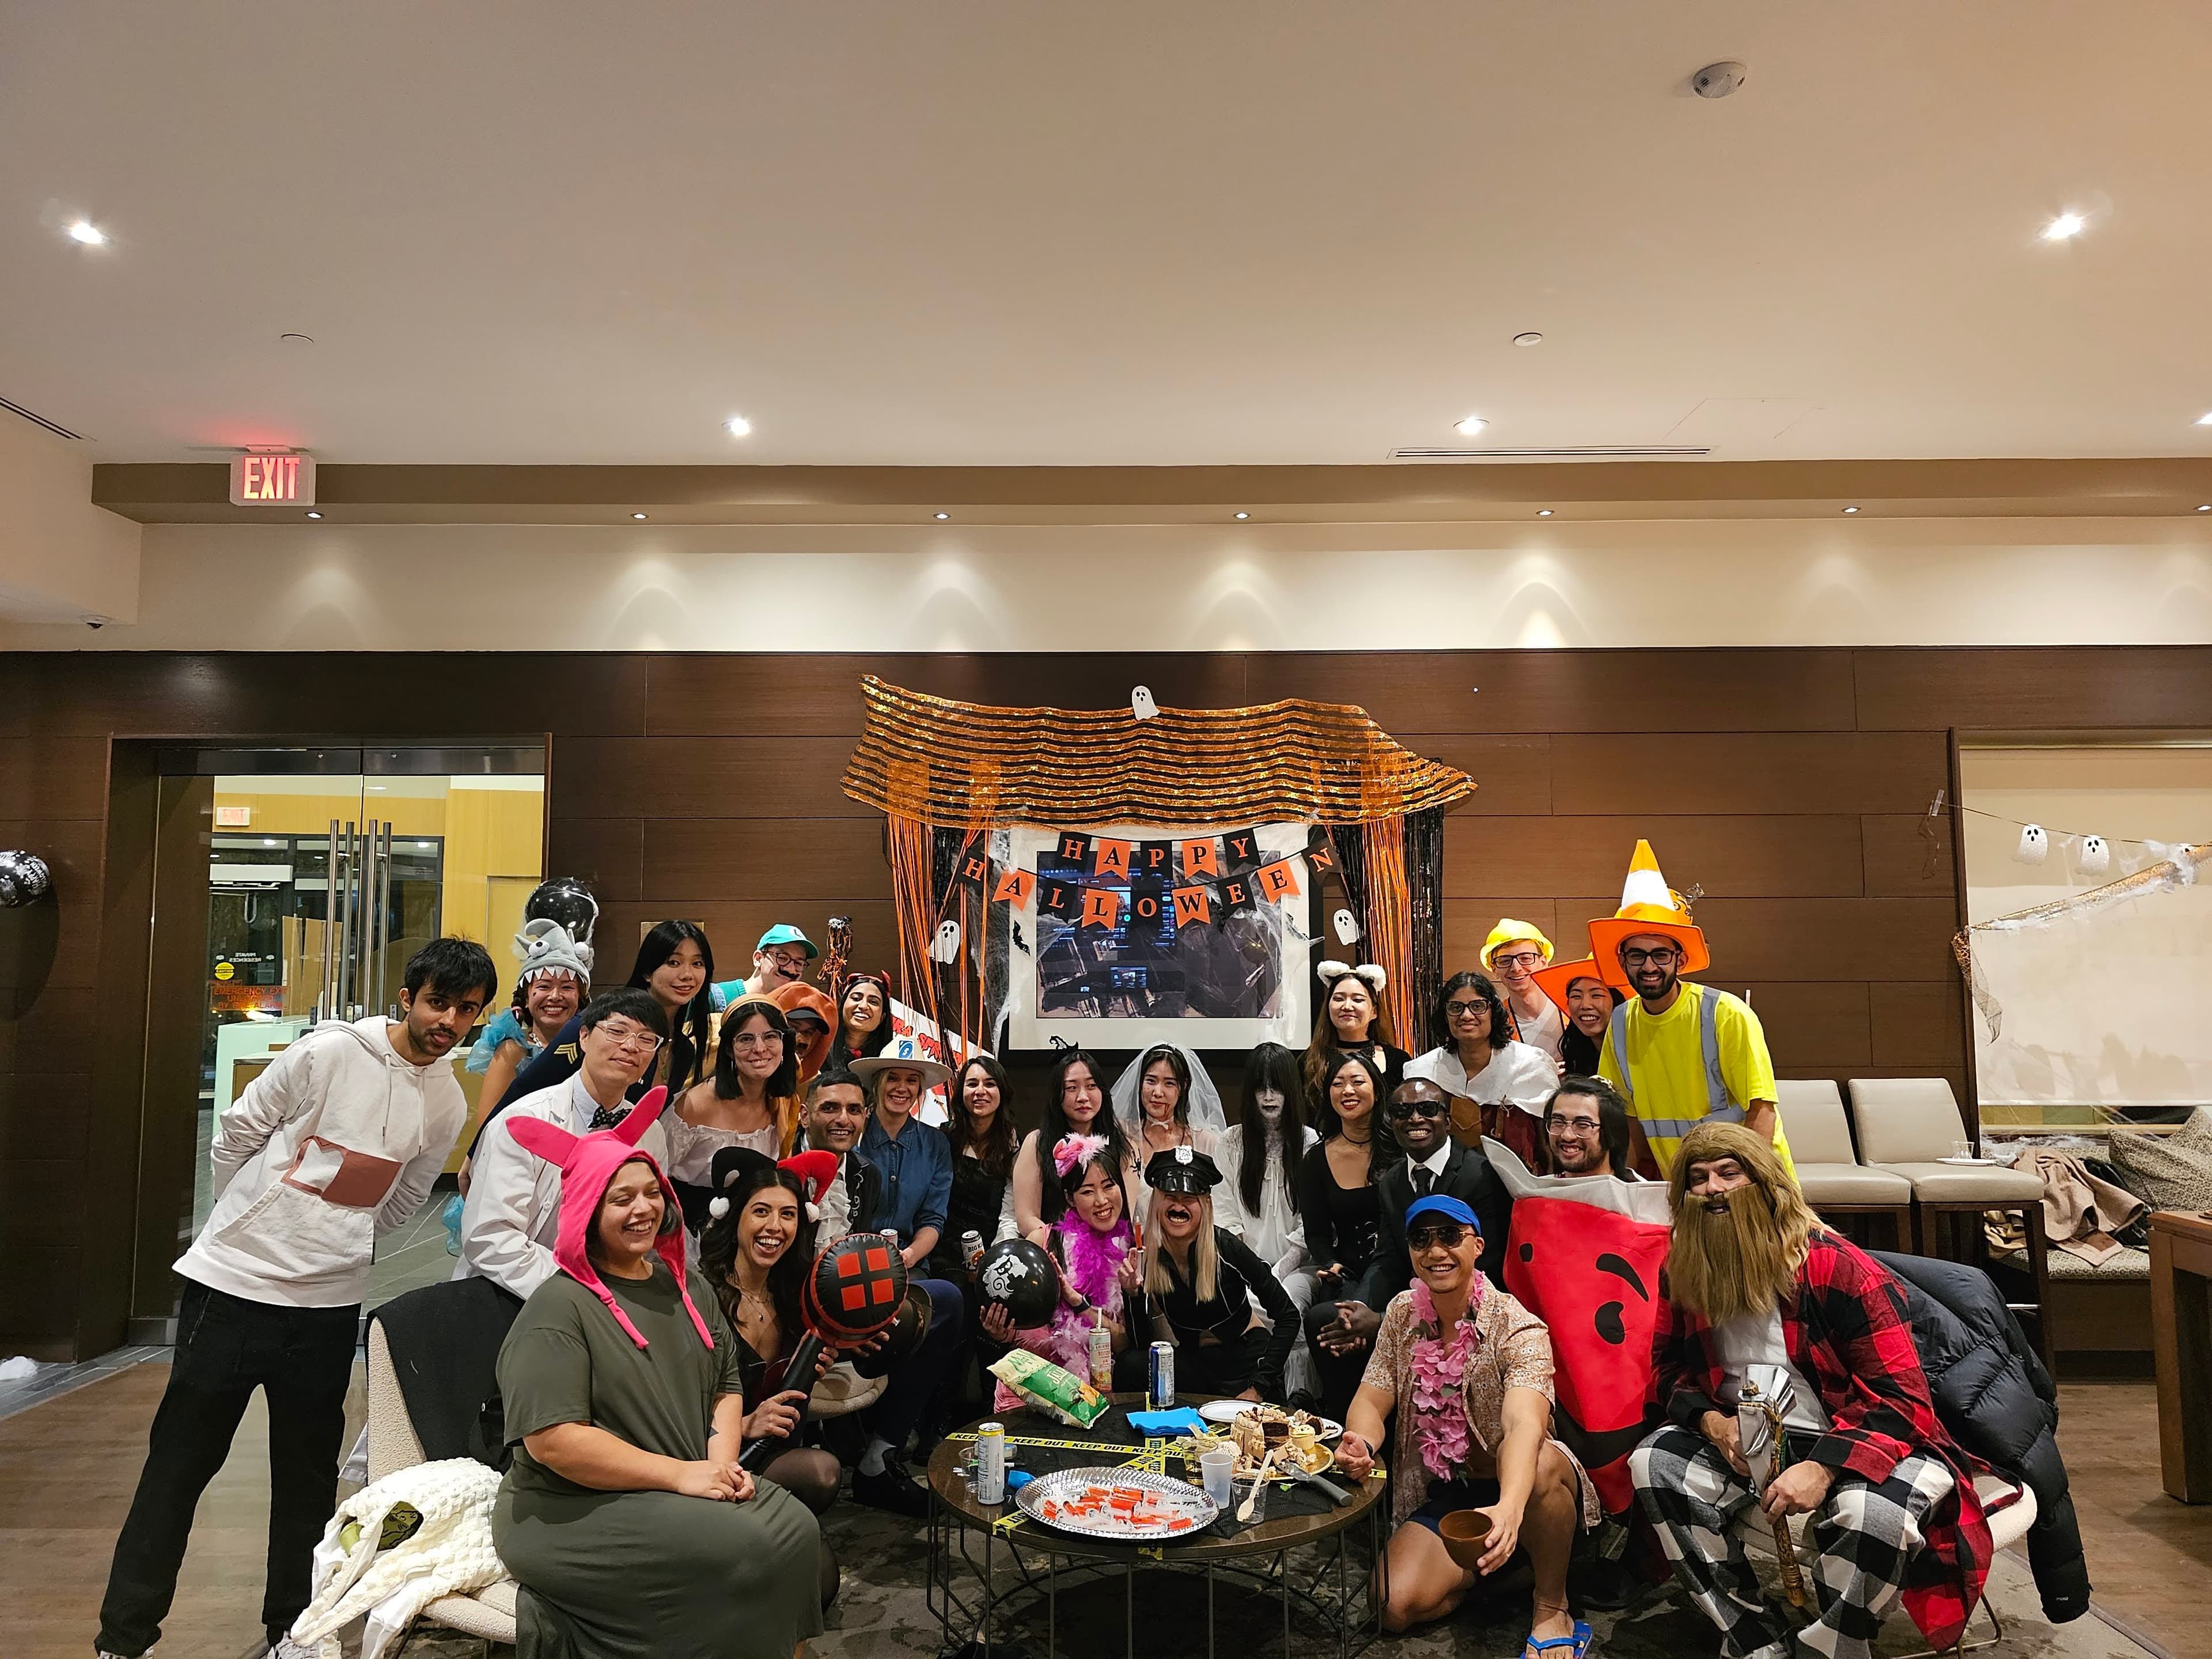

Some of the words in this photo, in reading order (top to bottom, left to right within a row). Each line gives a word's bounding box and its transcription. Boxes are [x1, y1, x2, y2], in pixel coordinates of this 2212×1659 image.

[243, 457, 300, 499] EXIT
[1062, 838, 1249, 867] HAPPY
[962, 847, 1334, 918] HALLOWEEN
